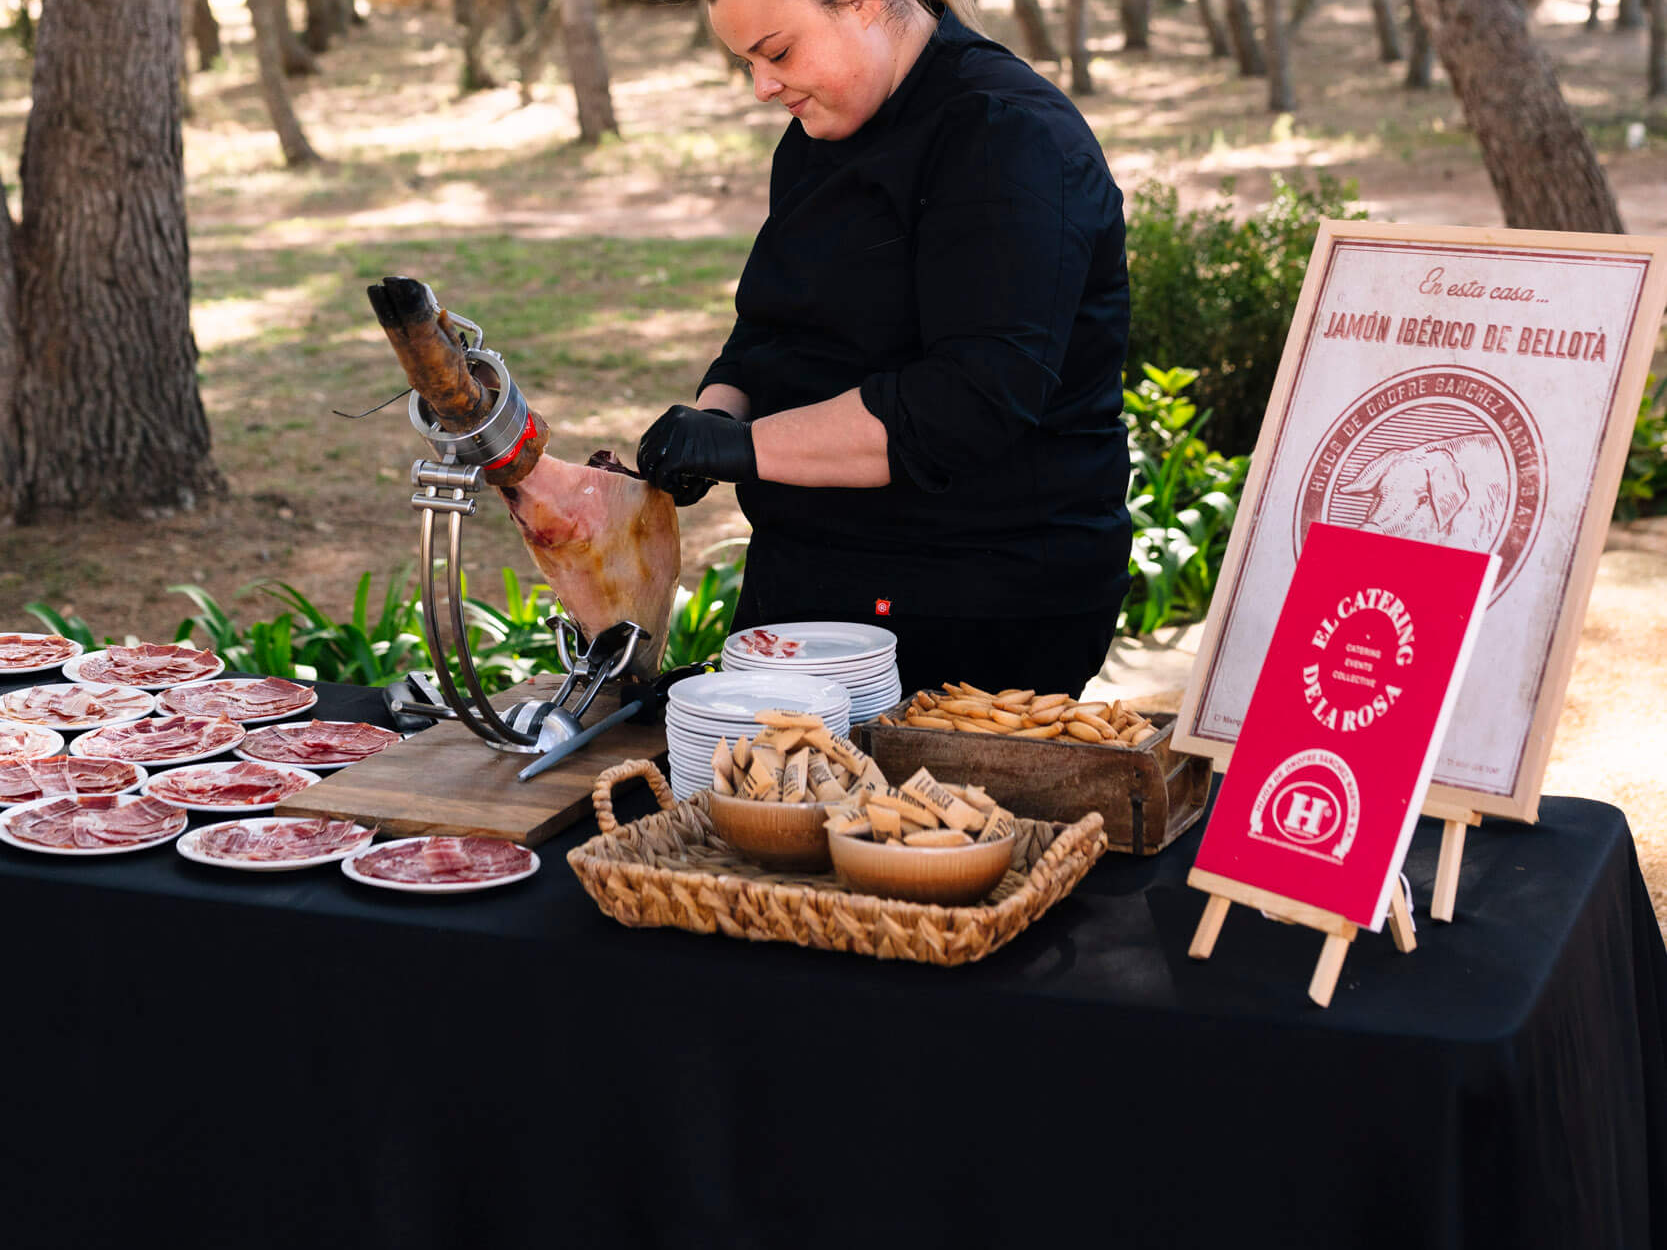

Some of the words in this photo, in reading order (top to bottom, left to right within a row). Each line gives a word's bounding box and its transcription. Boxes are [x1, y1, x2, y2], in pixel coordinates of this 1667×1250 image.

[1419, 267, 1445, 296] En
[1447, 280, 1486, 299] esta
[1323, 310, 1391, 343] JAMÓN
[1396, 315, 1478, 351] IBÉRICO
[1482, 323, 1512, 354] DE
[1516, 327, 1607, 363] BELLOTA
[1310, 440, 1344, 492] HIJOS
[1342, 414, 1363, 438] DE
[1366, 378, 1428, 417] ONOFRE
[1435, 377, 1505, 414] SANCHEZ
[1311, 618, 1339, 650] EL
[1337, 588, 1415, 666] CATERING
[1303, 662, 1322, 704] DE
[1312, 696, 1338, 731] LA
[1341, 684, 1403, 732] ROSA
[1283, 790, 1330, 836] H
